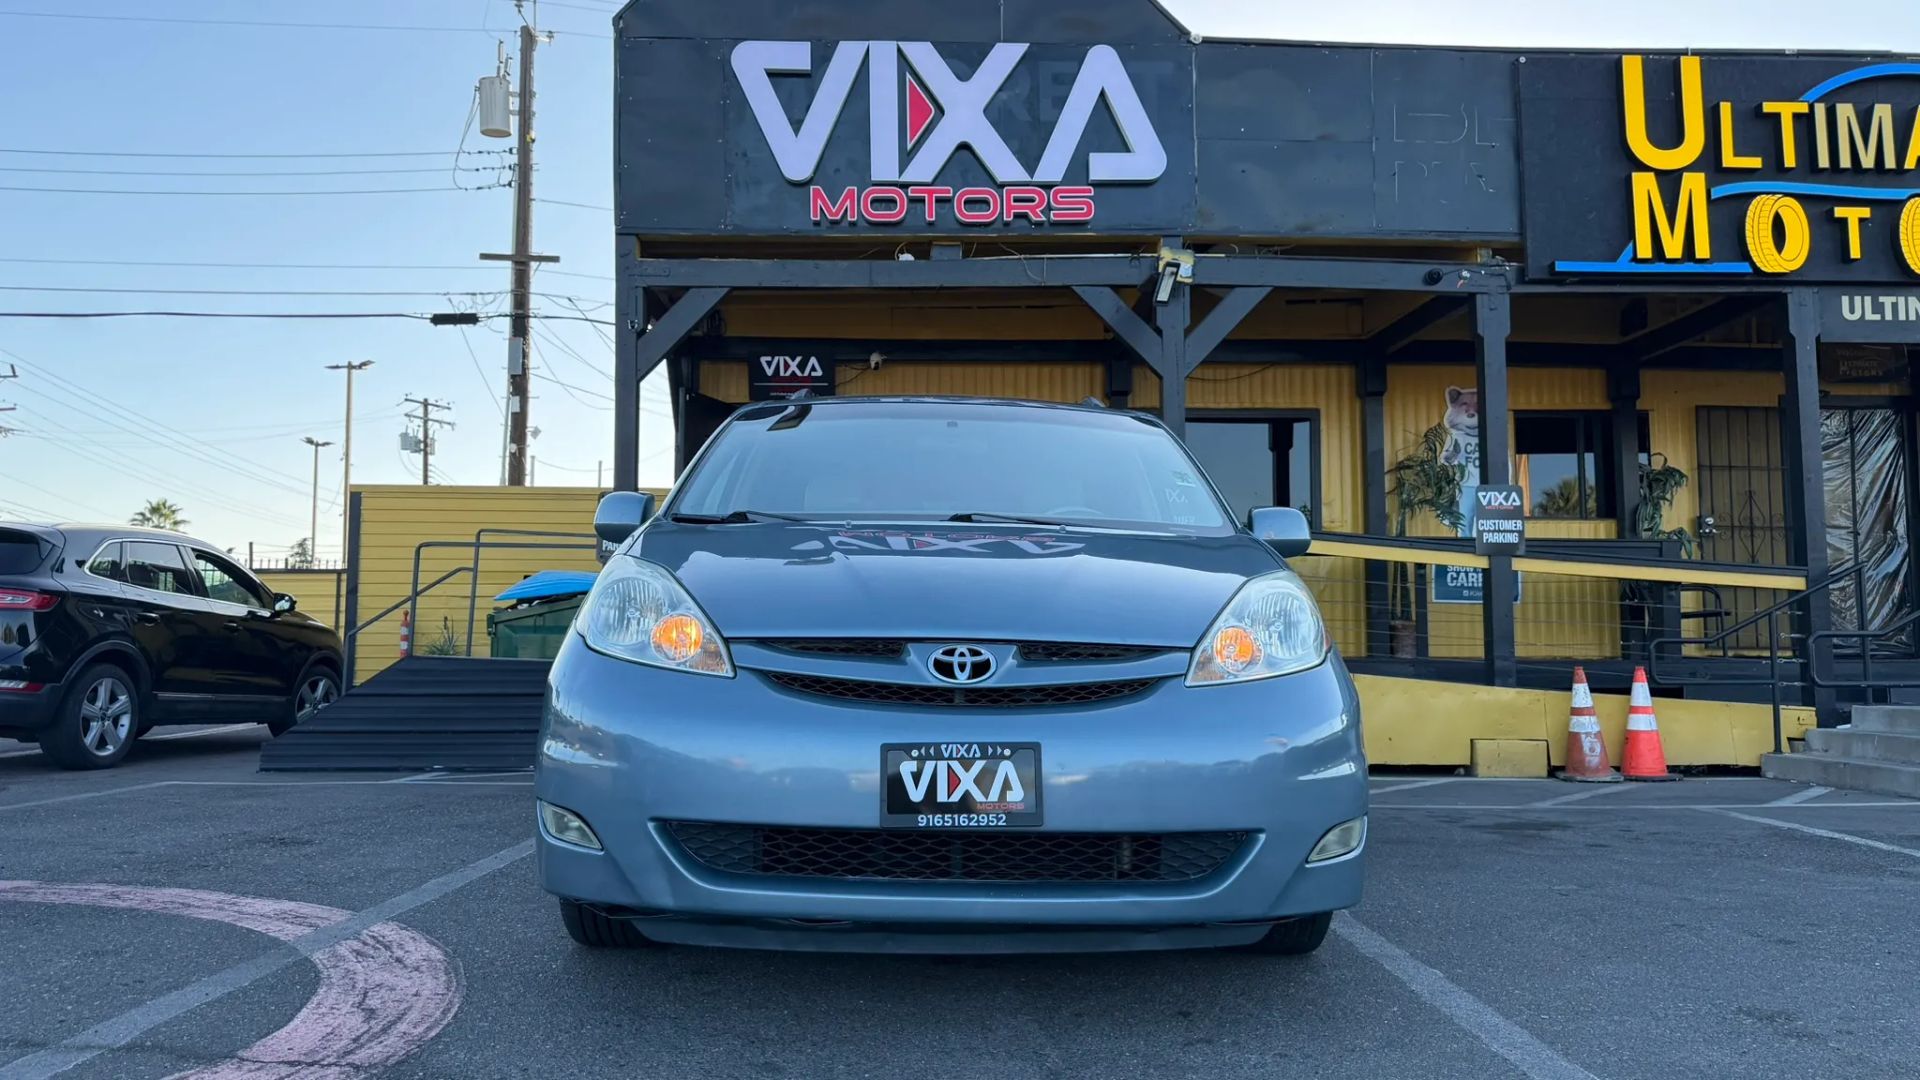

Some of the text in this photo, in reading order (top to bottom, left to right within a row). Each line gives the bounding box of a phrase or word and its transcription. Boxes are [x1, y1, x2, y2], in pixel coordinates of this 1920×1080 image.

[731, 40, 1167, 184] VIXA
[810, 185, 1095, 224] MOTORS
[760, 356, 823, 377] VIXA
[1477, 491, 1521, 506] VIXA
[1478, 519, 1523, 531] CUSTOMER
[1483, 532, 1519, 543] PARKING
[940, 743, 981, 758] VIXA
[899, 760, 1025, 802] VIXA
[976, 802, 1025, 810] MOTORS
[917, 813, 1007, 827] 9165162952
